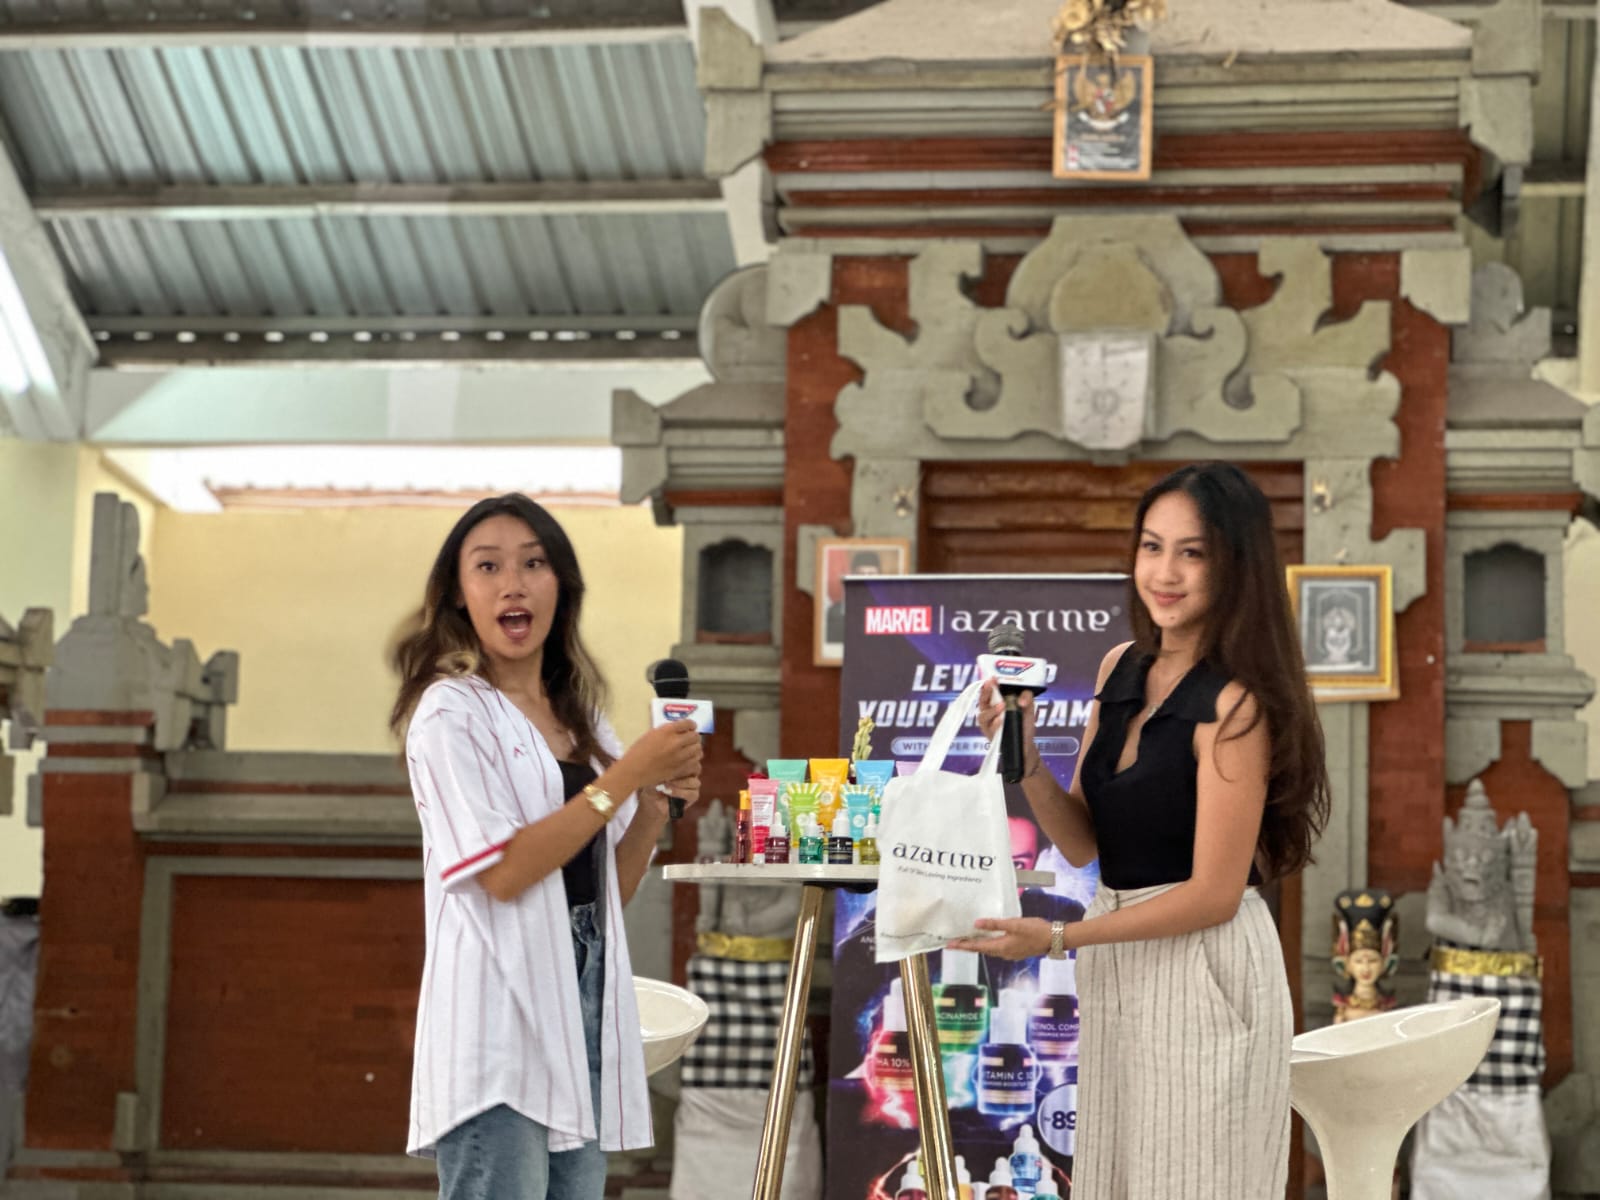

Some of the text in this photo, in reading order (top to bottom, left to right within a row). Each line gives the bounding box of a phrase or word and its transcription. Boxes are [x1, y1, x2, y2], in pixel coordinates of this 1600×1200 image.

[866, 608, 930, 632] MARVEL
[912, 664, 979, 691] LEV
[859, 700, 939, 727] YOUR
[1034, 700, 1096, 727] GAM
[892, 842, 994, 871] azarine
[1017, 1071, 1024, 1080] C
